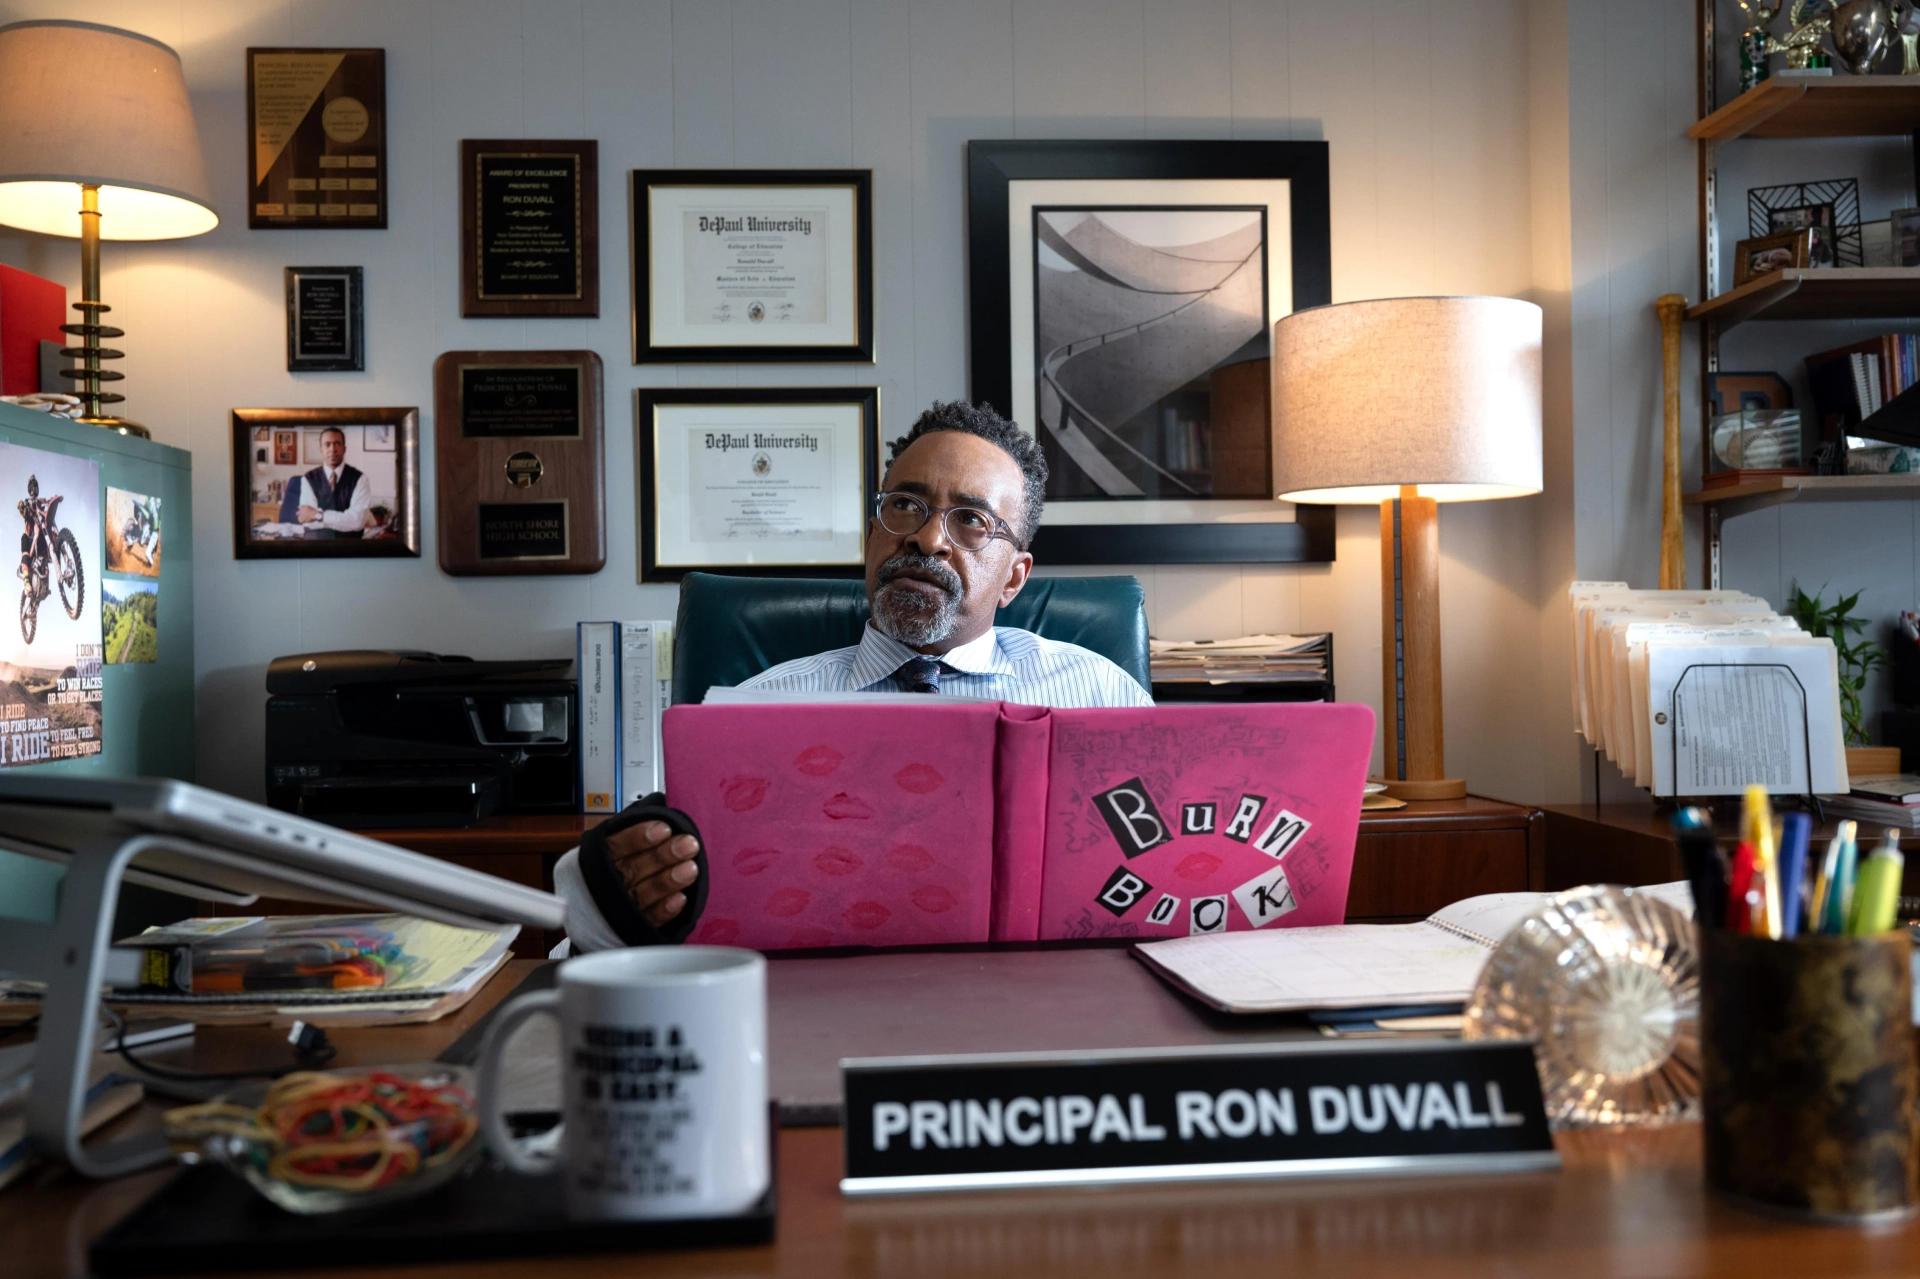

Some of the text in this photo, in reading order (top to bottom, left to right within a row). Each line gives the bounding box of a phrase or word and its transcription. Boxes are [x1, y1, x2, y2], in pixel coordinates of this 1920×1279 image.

[489, 169, 568, 177] AWARD OF EXCELLENCE
[502, 195, 554, 204] RON DUVALL
[699, 216, 812, 235] DePaul University
[705, 434, 818, 452] DePaul University
[486, 519, 560, 530] NORTH SHORE
[486, 530, 560, 541] HIGH SCHOOL
[76, 644, 79, 656] I
[76, 658, 102, 678] RIDE
[57, 678, 102, 690] TO WIN RACES
[48, 690, 102, 705] OR TO GET PLACES
[6, 703, 26, 719] RIDE
[0, 718, 48, 734] TO FIND PEACE
[50, 726, 94, 742] TO FEEL FREE
[0, 730, 50, 764] I RIDE
[51, 740, 101, 758] TO FEEL STRONG
[873, 1081, 1525, 1151] PRINCIPAL RON DUVALL
